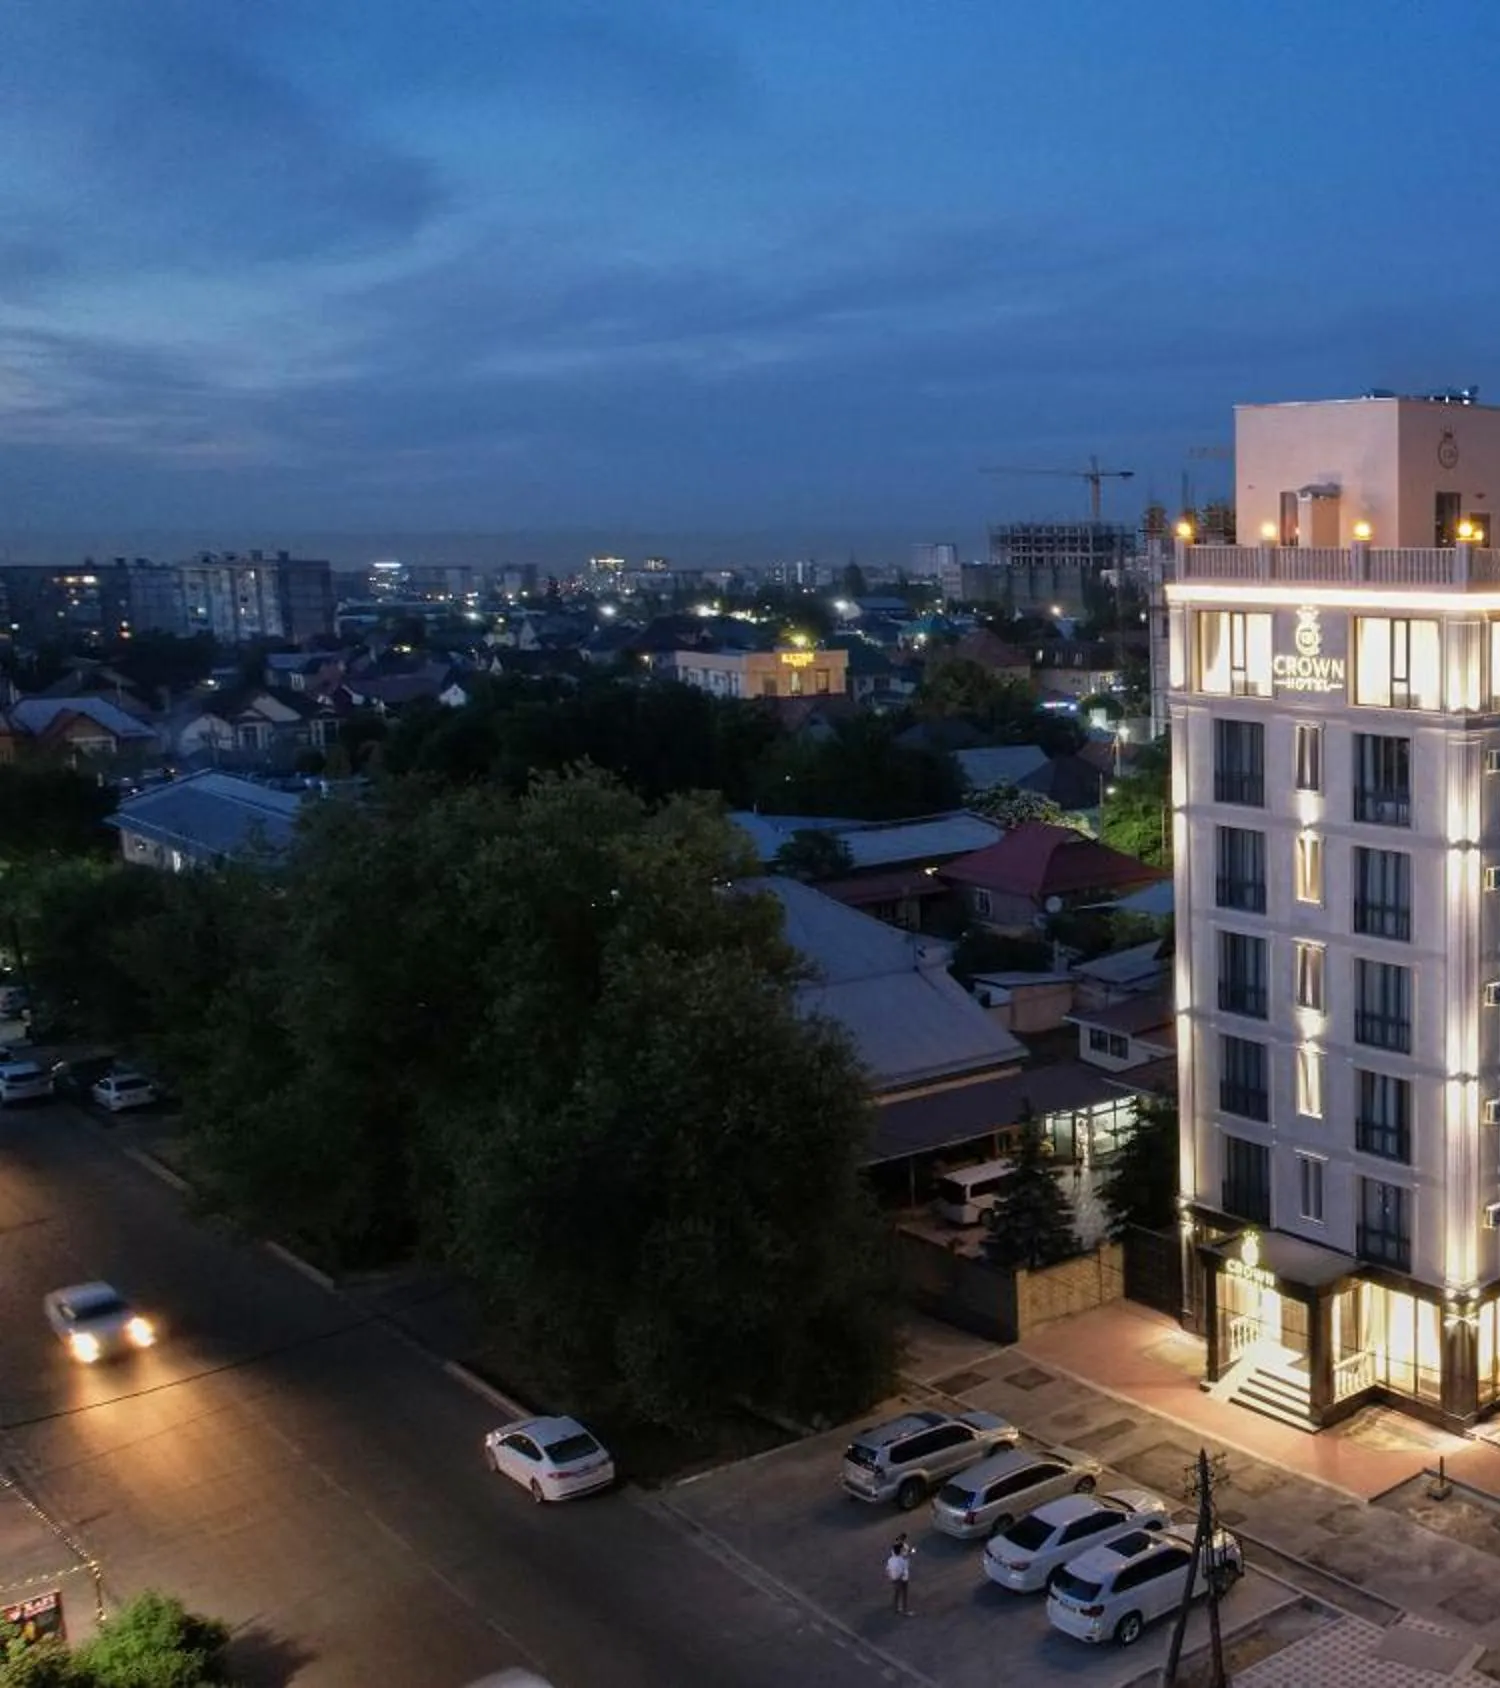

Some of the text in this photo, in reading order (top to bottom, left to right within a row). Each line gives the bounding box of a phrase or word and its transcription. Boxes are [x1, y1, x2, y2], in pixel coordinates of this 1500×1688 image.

[1274, 655, 1344, 679] CROWN
[1286, 678, 1331, 692] HOTEL
[1225, 1258, 1275, 1287] CROWN
